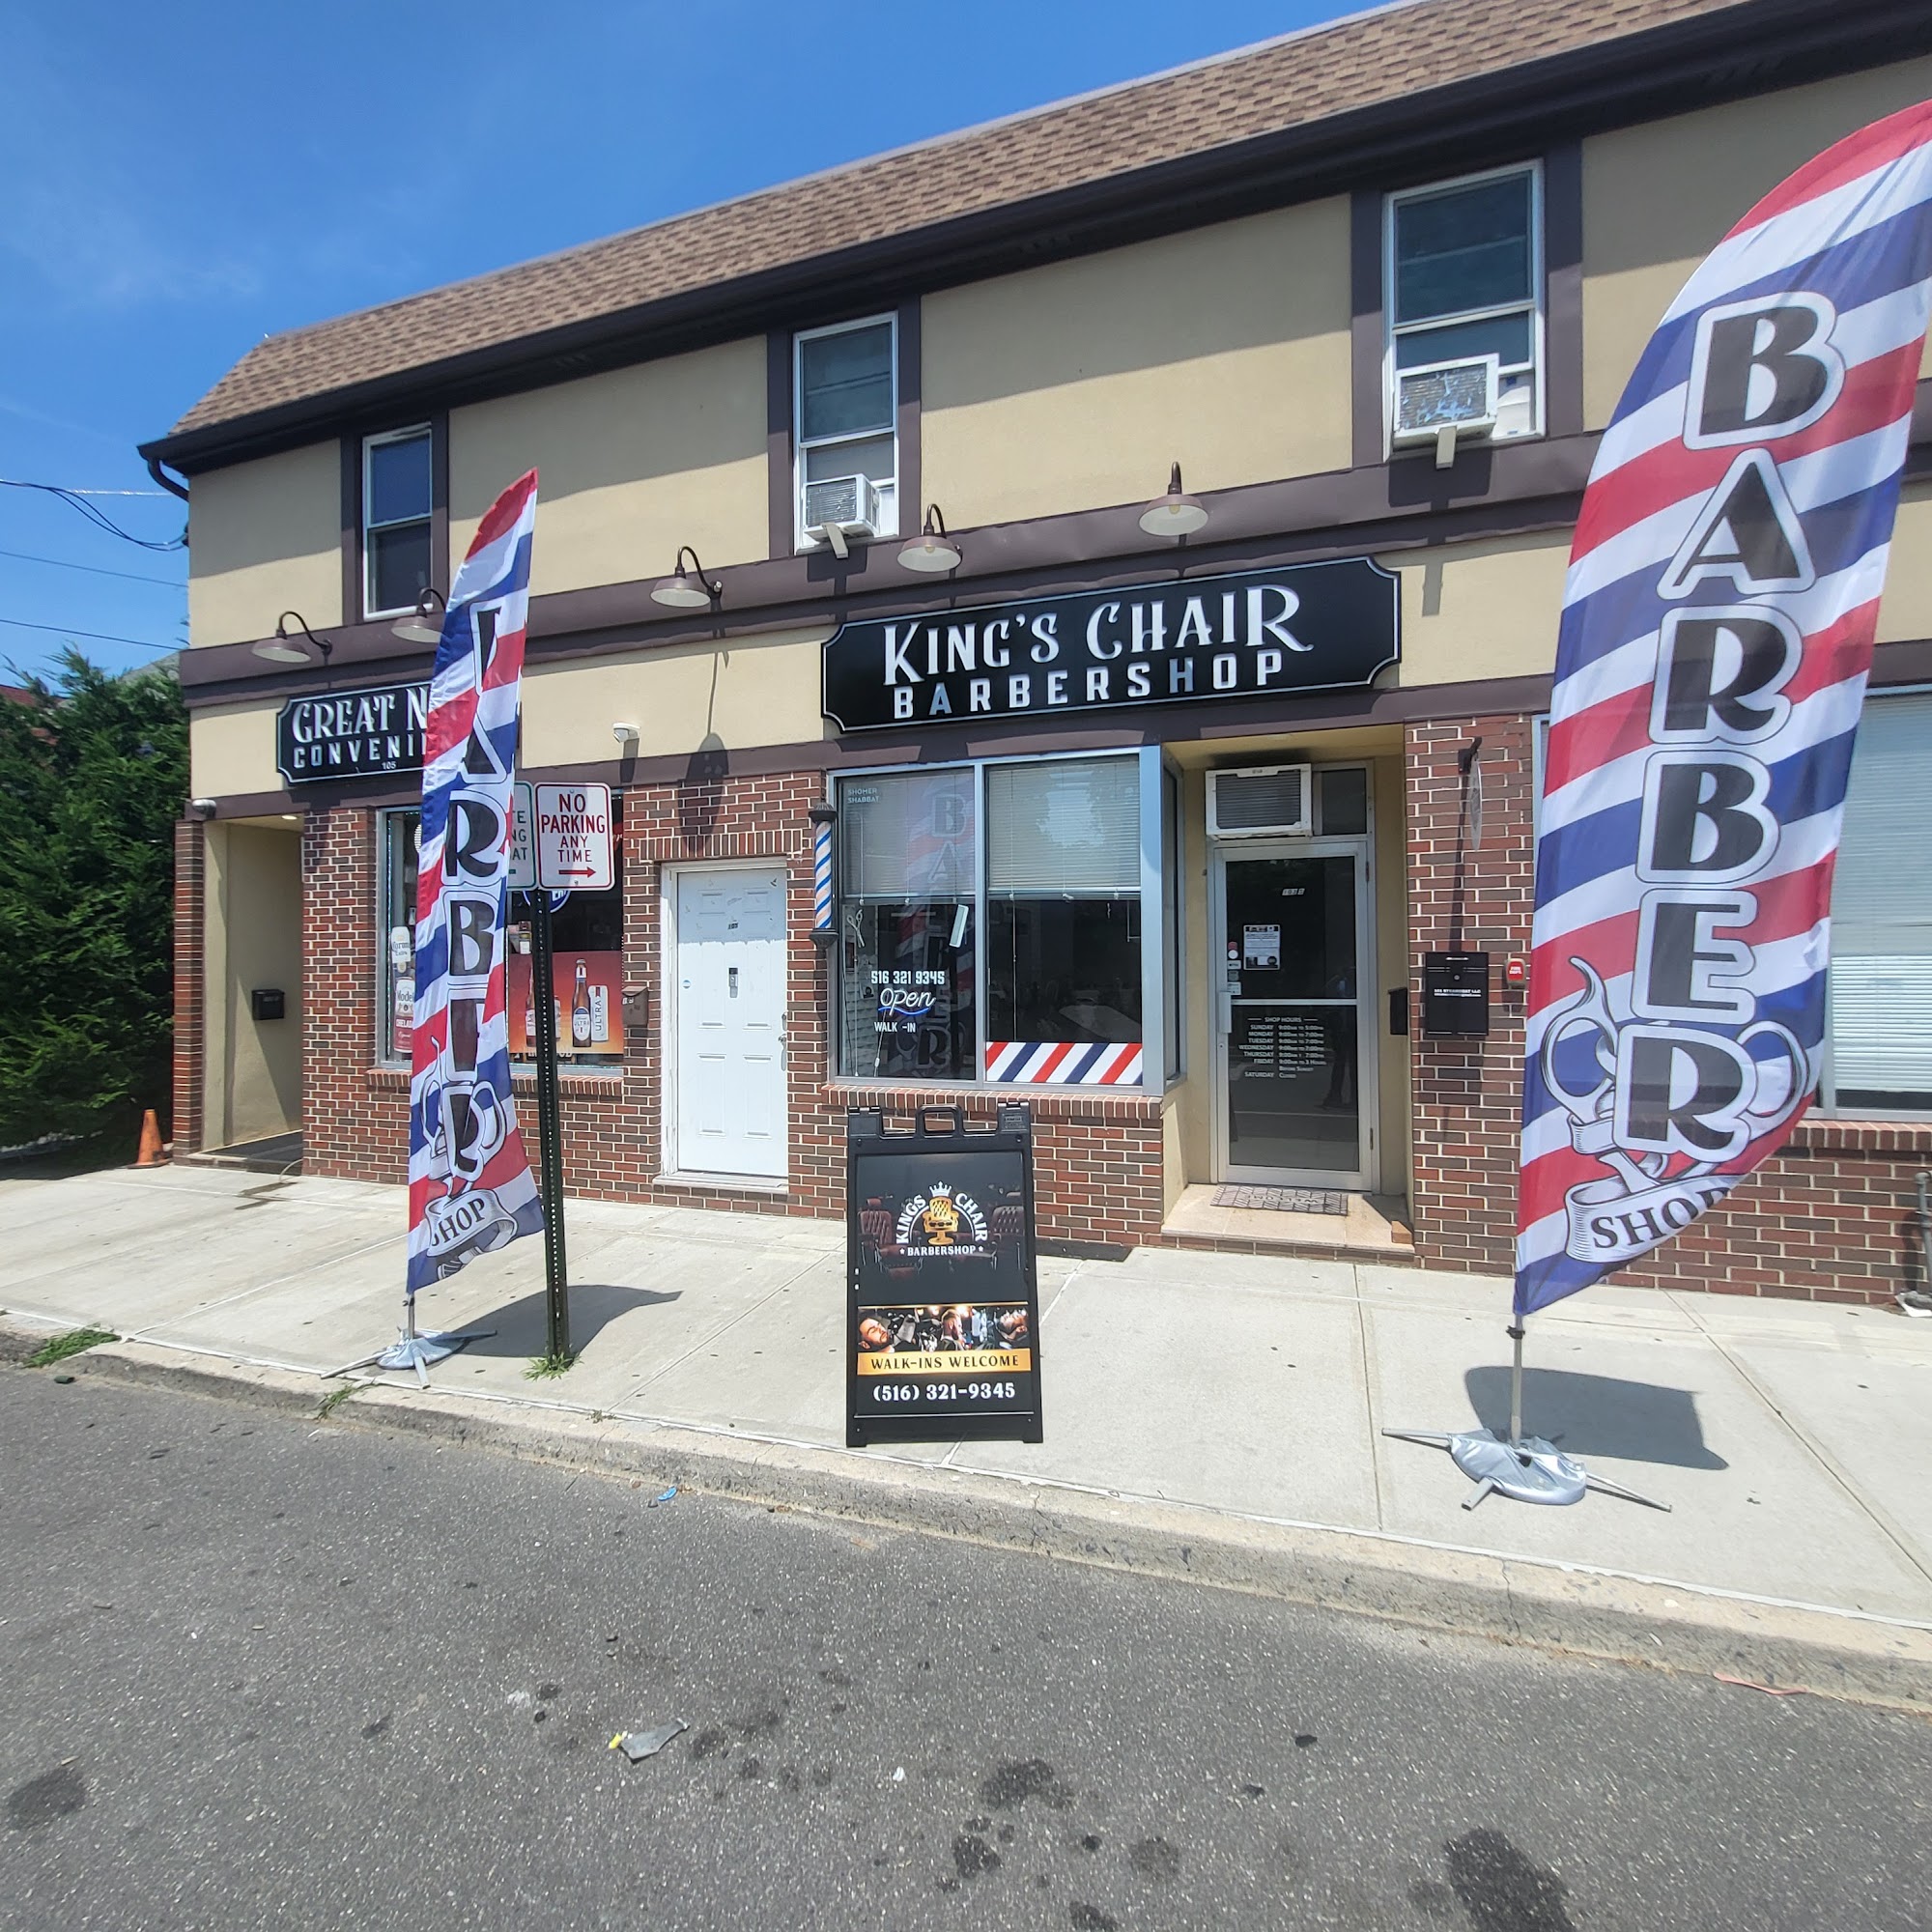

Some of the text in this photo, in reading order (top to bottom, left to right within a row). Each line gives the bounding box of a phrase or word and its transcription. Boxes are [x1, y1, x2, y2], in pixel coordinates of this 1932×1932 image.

[882, 584, 1315, 687] KING'S CHAIR
[894, 648, 1282, 719] BARBERSHOP
[292, 686, 429, 743] GREAT N
[1613, 292, 1846, 1162] BARBER
[382, 761, 396, 770] 105
[558, 793, 586, 812] NO
[541, 814, 606, 834] PARKING
[560, 836, 588, 849] ANY
[557, 849, 593, 863] TIME
[871, 971, 945, 985] 516 321 9345
[880, 987, 936, 1015] Open
[874, 1022, 897, 1033] WALK
[895, 1192, 988, 1244] KINGS CHAIR
[907, 1245, 977, 1256] BARBERSHOP
[870, 1355, 1019, 1370] WALK-INS WELCOME
[873, 1382, 1015, 1401] (516) 321-9345
